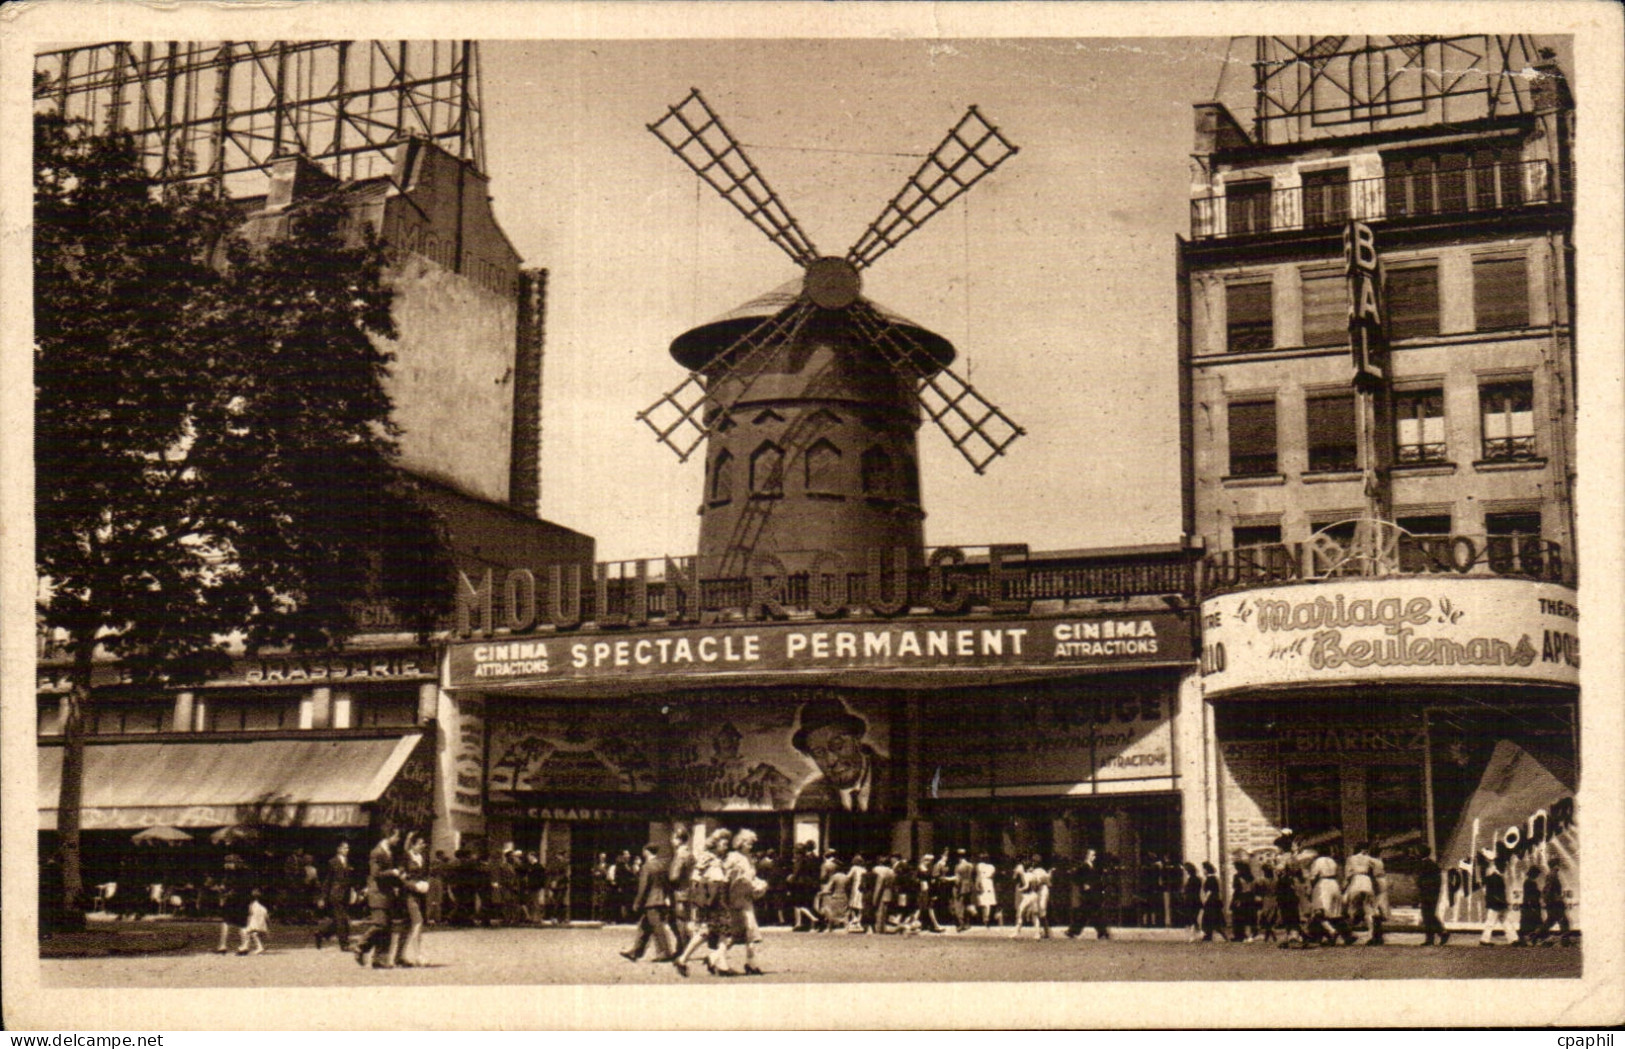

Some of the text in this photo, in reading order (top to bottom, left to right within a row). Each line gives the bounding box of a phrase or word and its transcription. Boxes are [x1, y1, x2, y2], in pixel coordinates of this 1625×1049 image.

[1354, 221, 1383, 379] BAL
[454, 543, 1029, 638] MOULIN ROUGE
[571, 629, 1028, 668] SPECTACLE PERMANENT
[1054, 639, 1159, 657] ATTRACTIONS
[246, 662, 421, 682] BRASSERIE
[474, 660, 550, 677] ATTRACTIONS
